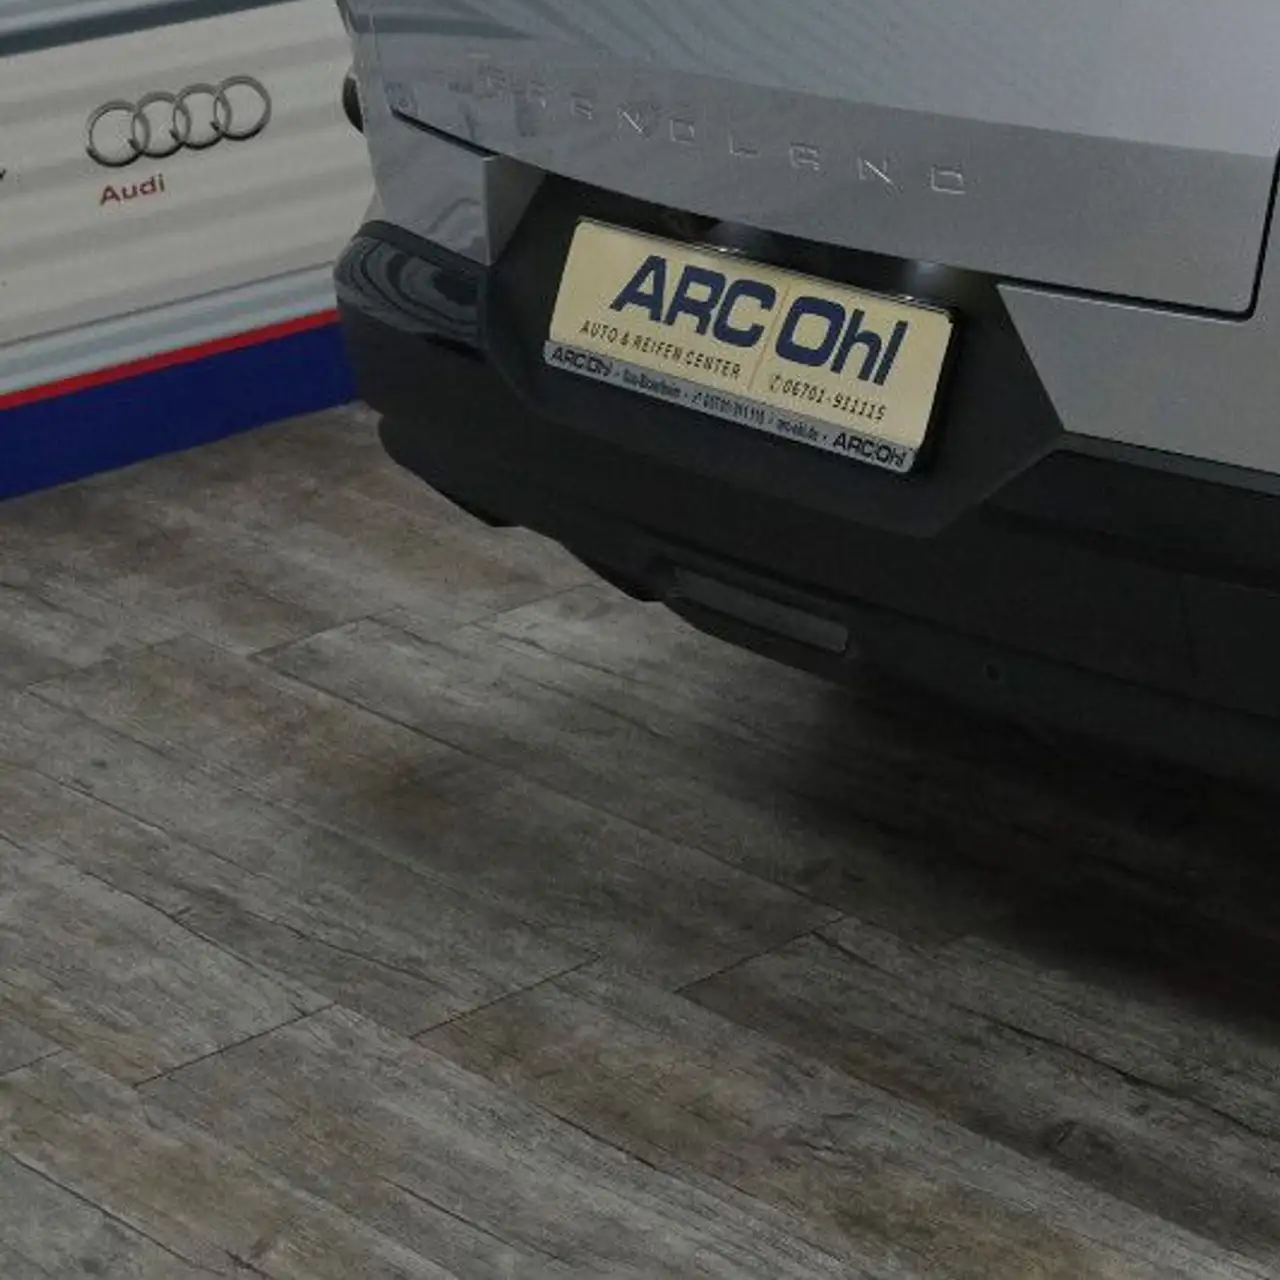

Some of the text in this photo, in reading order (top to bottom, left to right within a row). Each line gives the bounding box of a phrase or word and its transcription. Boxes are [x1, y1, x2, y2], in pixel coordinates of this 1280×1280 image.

[100, 173, 165, 205] Audi
[579, 320, 618, 343] AUTO
[633, 335, 684, 362] REIFEN
[685, 350, 741, 380] CENTER
[610, 255, 909, 386] ARC Ohl
